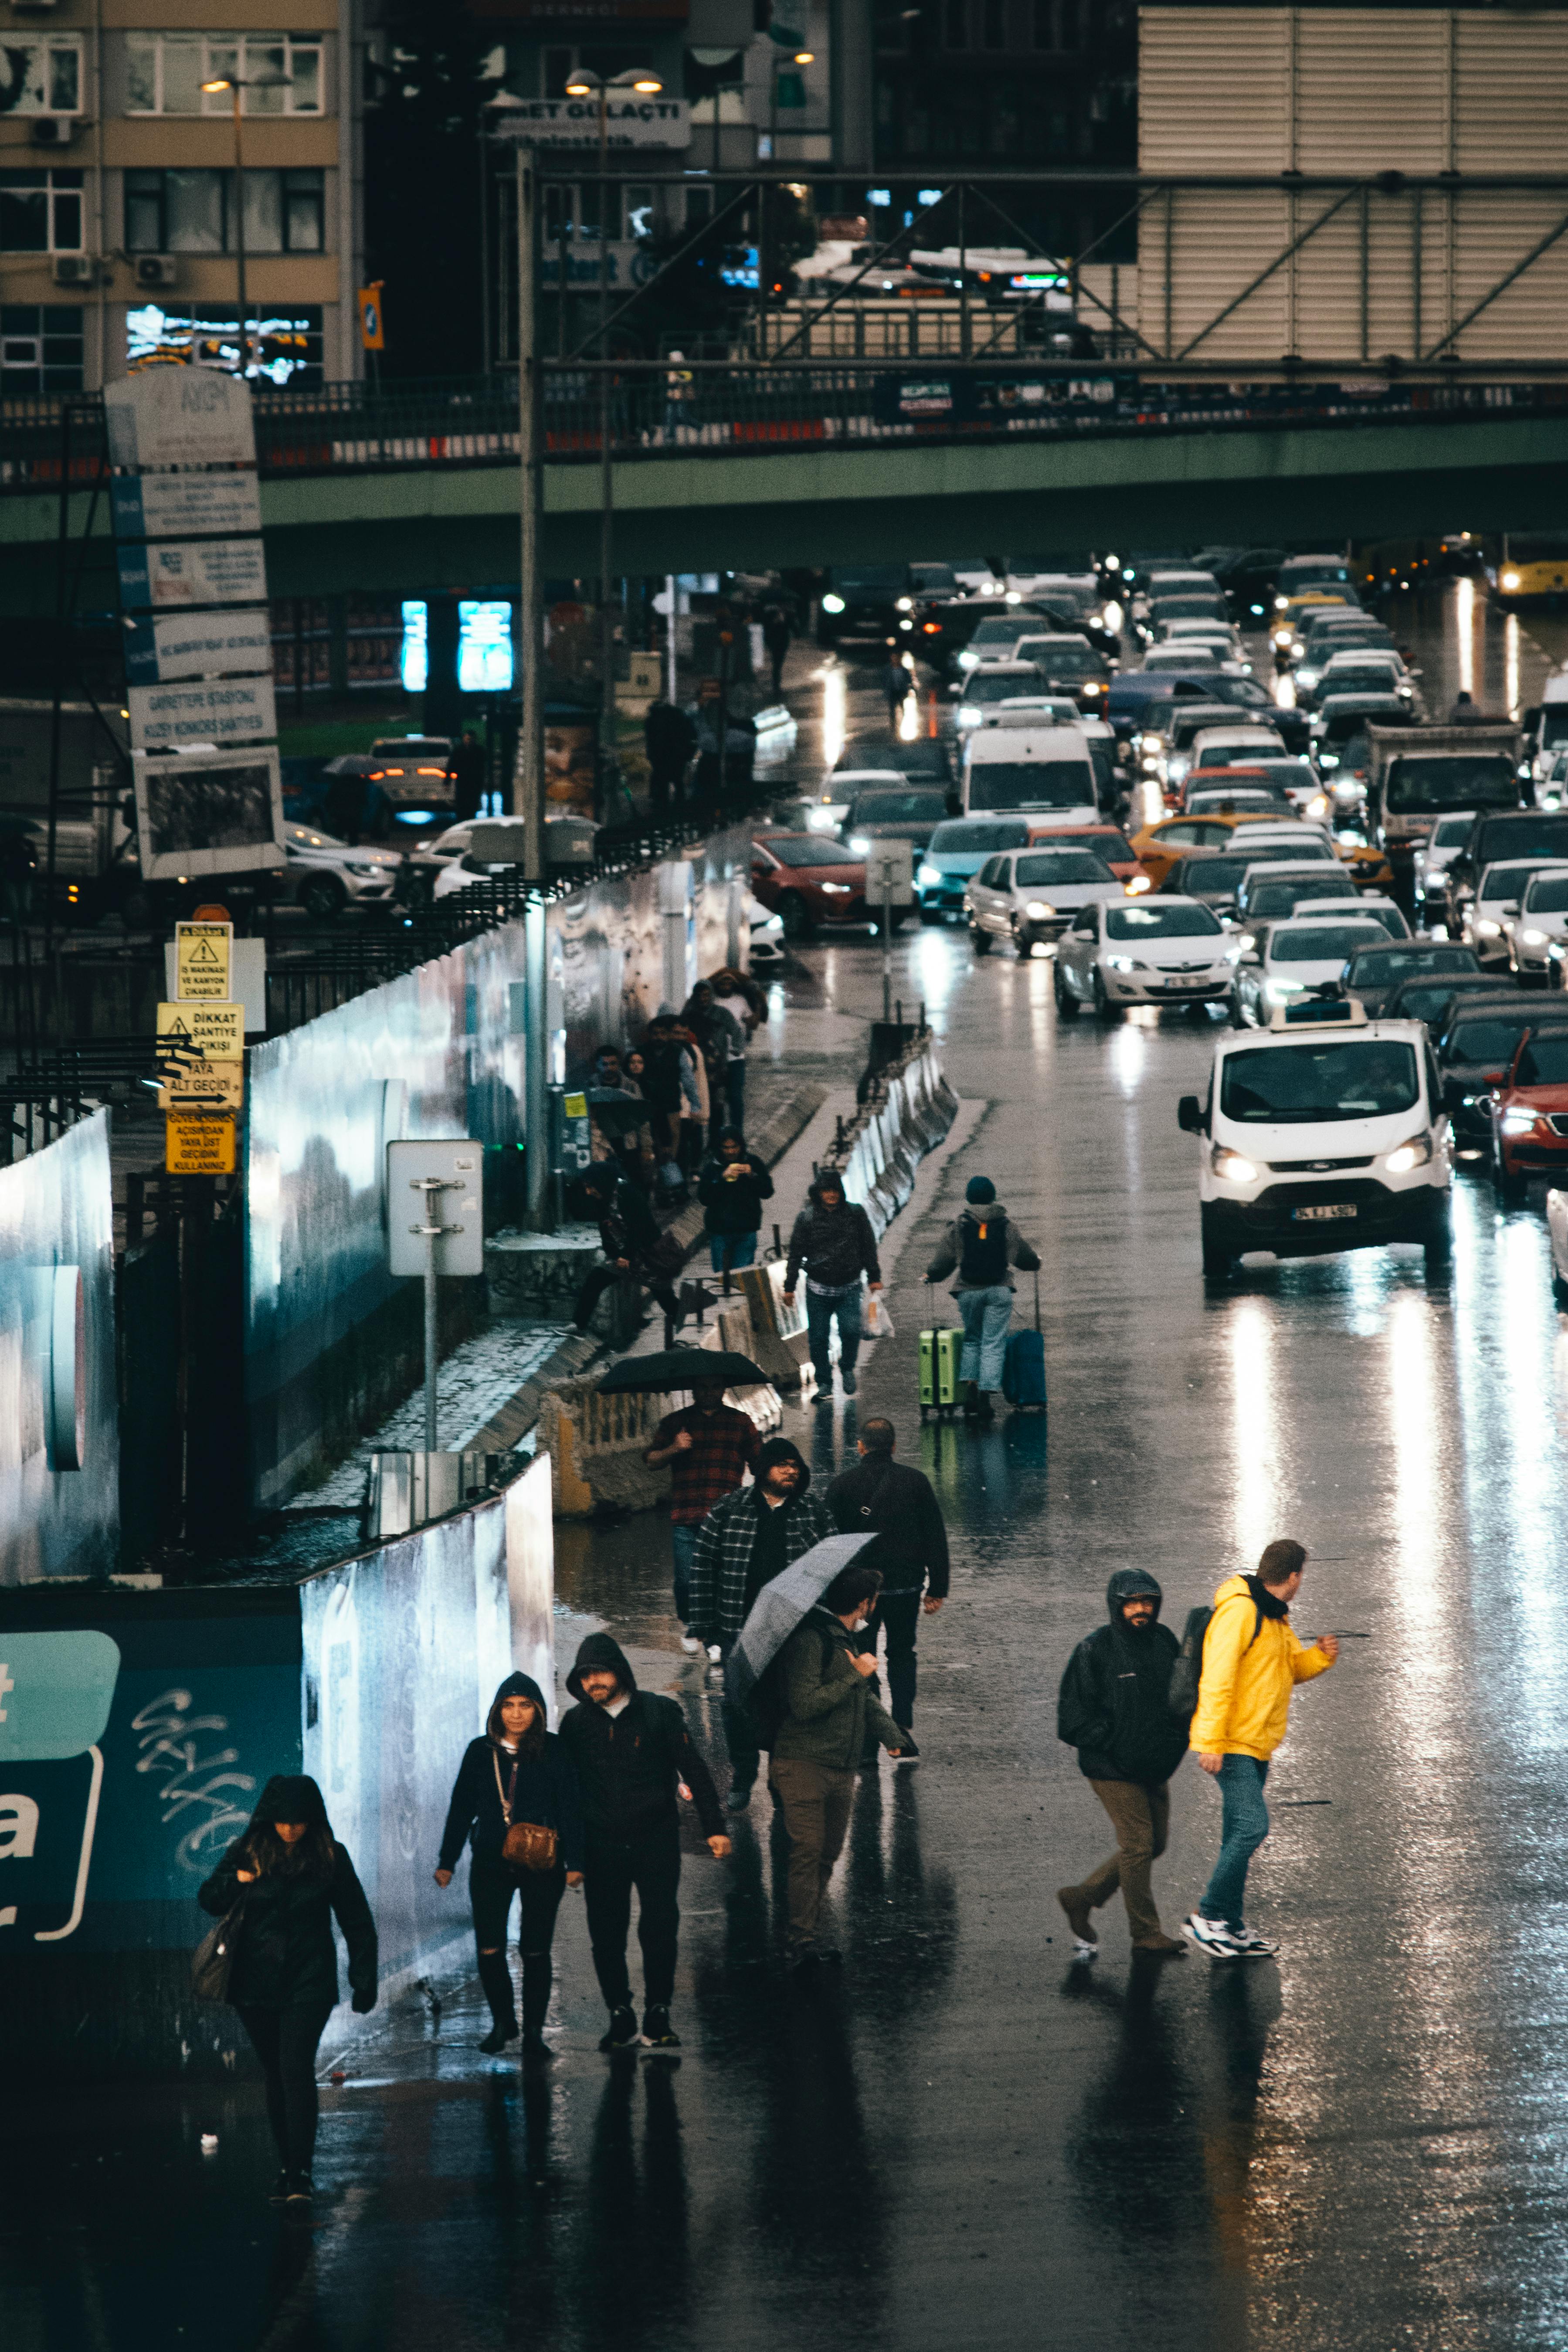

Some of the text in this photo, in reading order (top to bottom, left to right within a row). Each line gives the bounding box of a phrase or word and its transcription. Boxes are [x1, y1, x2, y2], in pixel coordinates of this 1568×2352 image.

[185, 987, 222, 997] ÇIKABİLİR
[193, 1011, 237, 1023] DİKKAT
[193, 1026, 237, 1037] ŞANTİYE
[189, 1064, 214, 1075] YAYA
[170, 1078, 231, 1093] ALT GEÇİDİ
[176, 1126, 224, 1136] AÇISINDAN
[180, 1135, 220, 1147] YAYA ÜST
[180, 1148, 219, 1159] GEÇİDİNİ
[174, 1161, 225, 1170] KULLANINIZ
